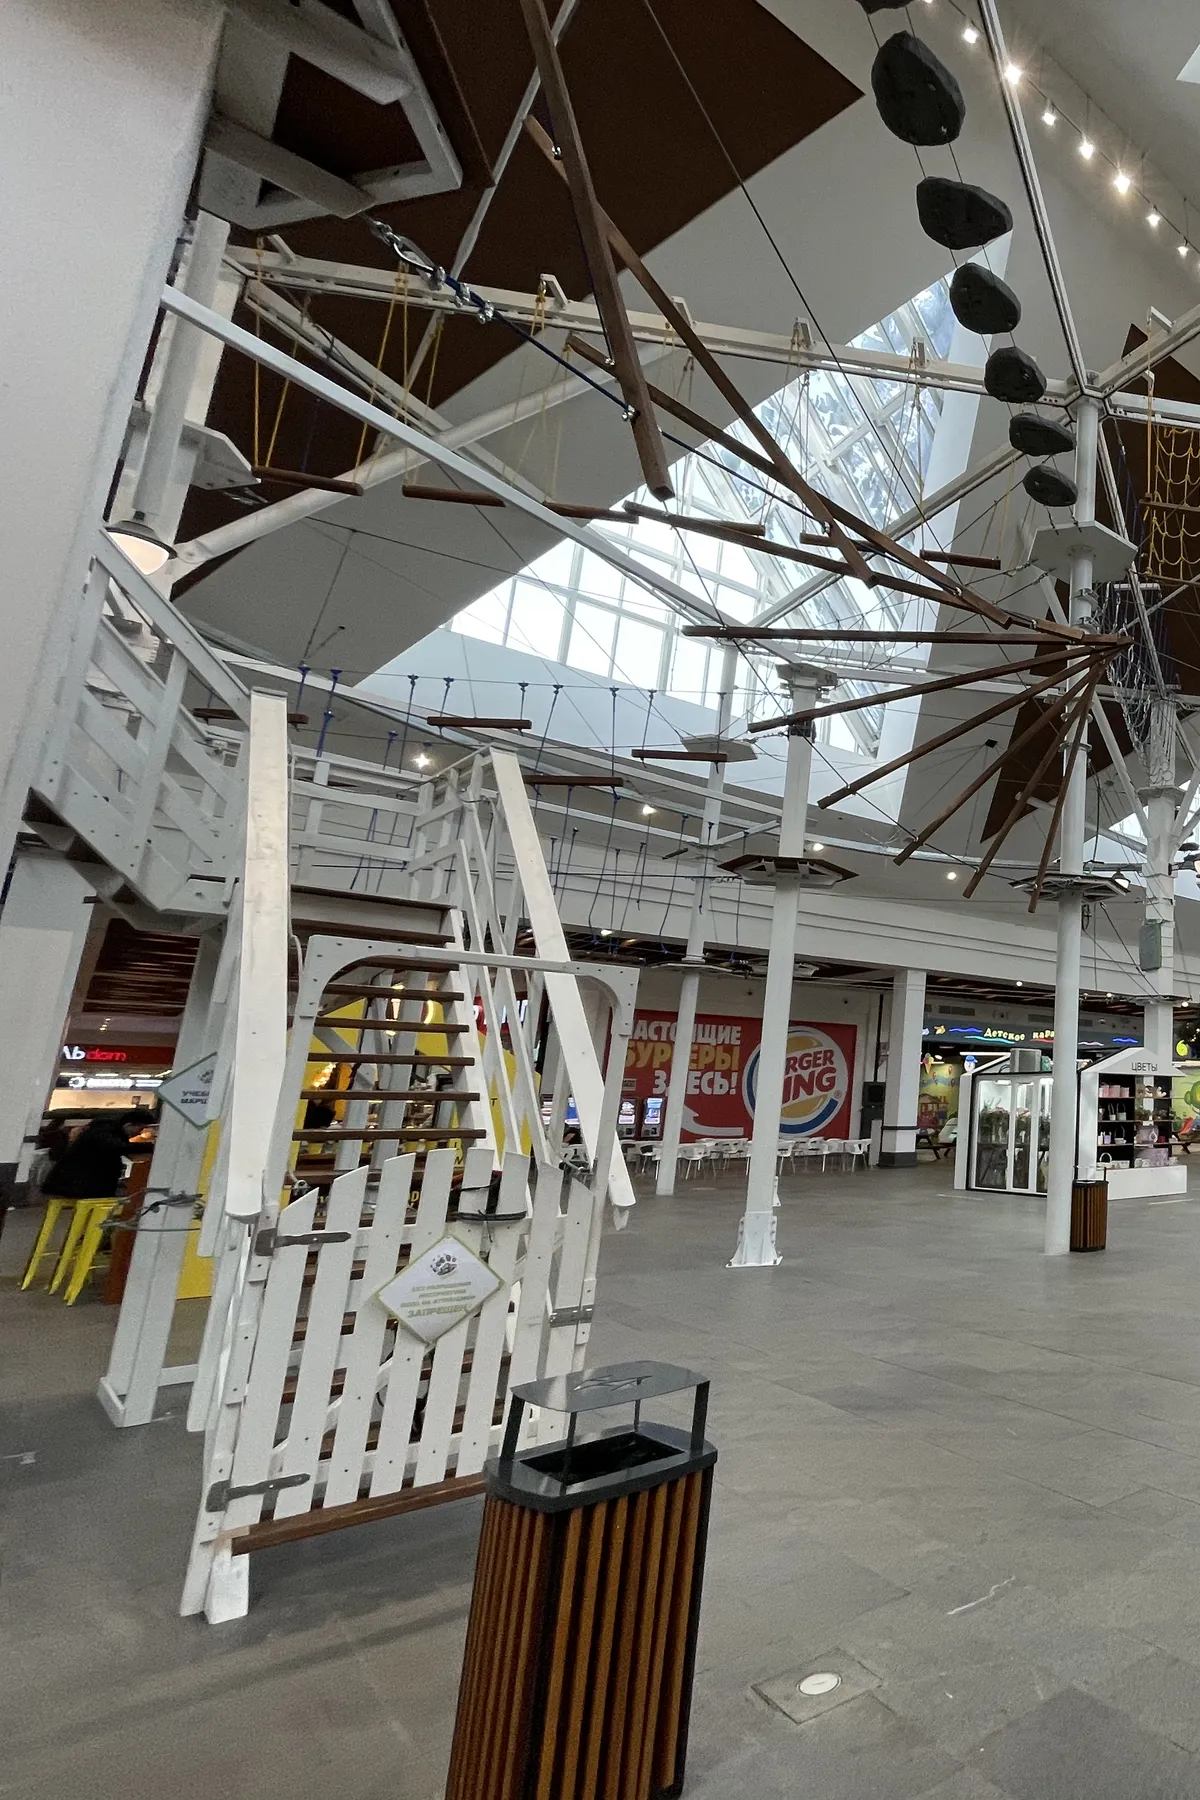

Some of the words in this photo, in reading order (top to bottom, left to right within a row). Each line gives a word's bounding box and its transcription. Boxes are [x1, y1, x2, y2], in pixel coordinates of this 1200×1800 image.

[633, 1019, 741, 1046] АСТОЩИЕ
[984, 1027, 1026, 1042] Детское
[1032, 1029, 1055, 1039] кара
[625, 1040, 740, 1071] БУРЕРЫ
[785, 1049, 835, 1075] RGER
[1131, 1061, 1158, 1072] ЦВЕТЫ
[652, 1070, 738, 1097] ЗЕСЬ!
[781, 1066, 837, 1104] ING
